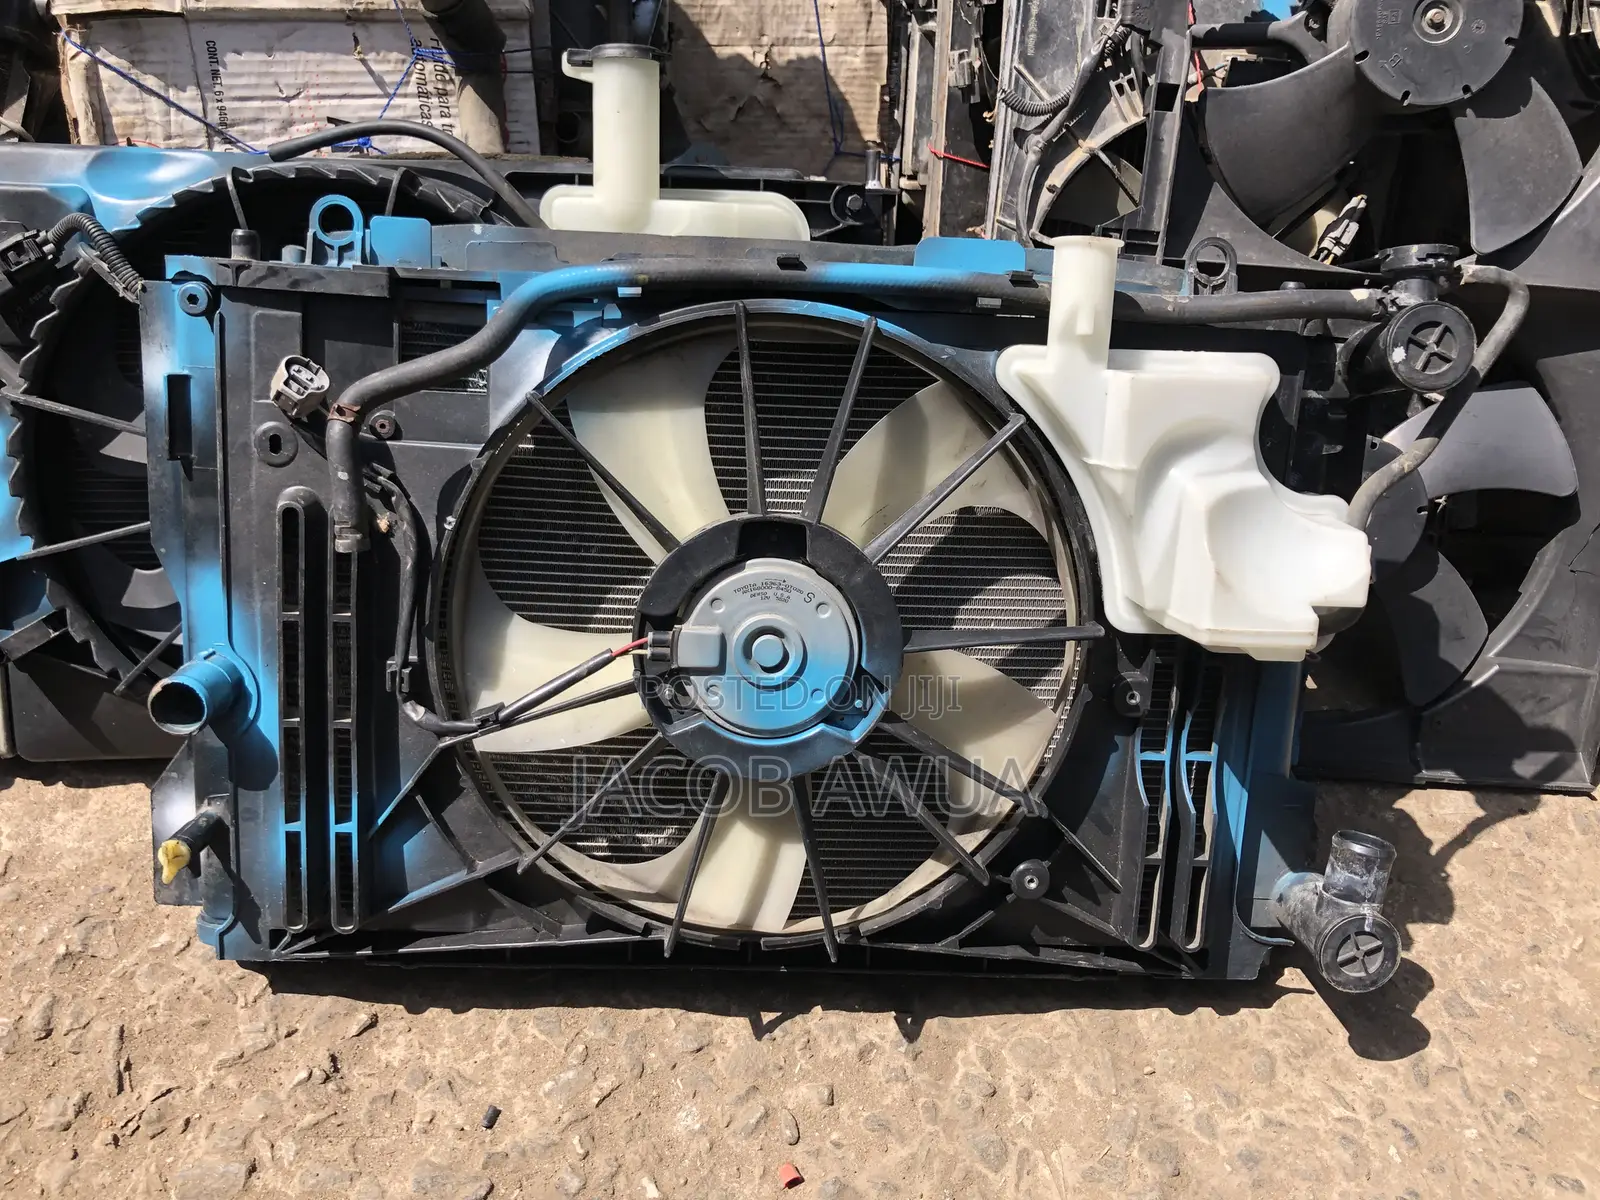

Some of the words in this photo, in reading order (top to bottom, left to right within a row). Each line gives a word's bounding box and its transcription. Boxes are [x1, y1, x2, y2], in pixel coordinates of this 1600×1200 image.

[205, 40, 219, 67] CONT.
[210, 69, 223, 88] NET.
[433, 86, 452, 119] para
[733, 583, 757, 594] TOYOTA
[803, 592, 816, 604] S
